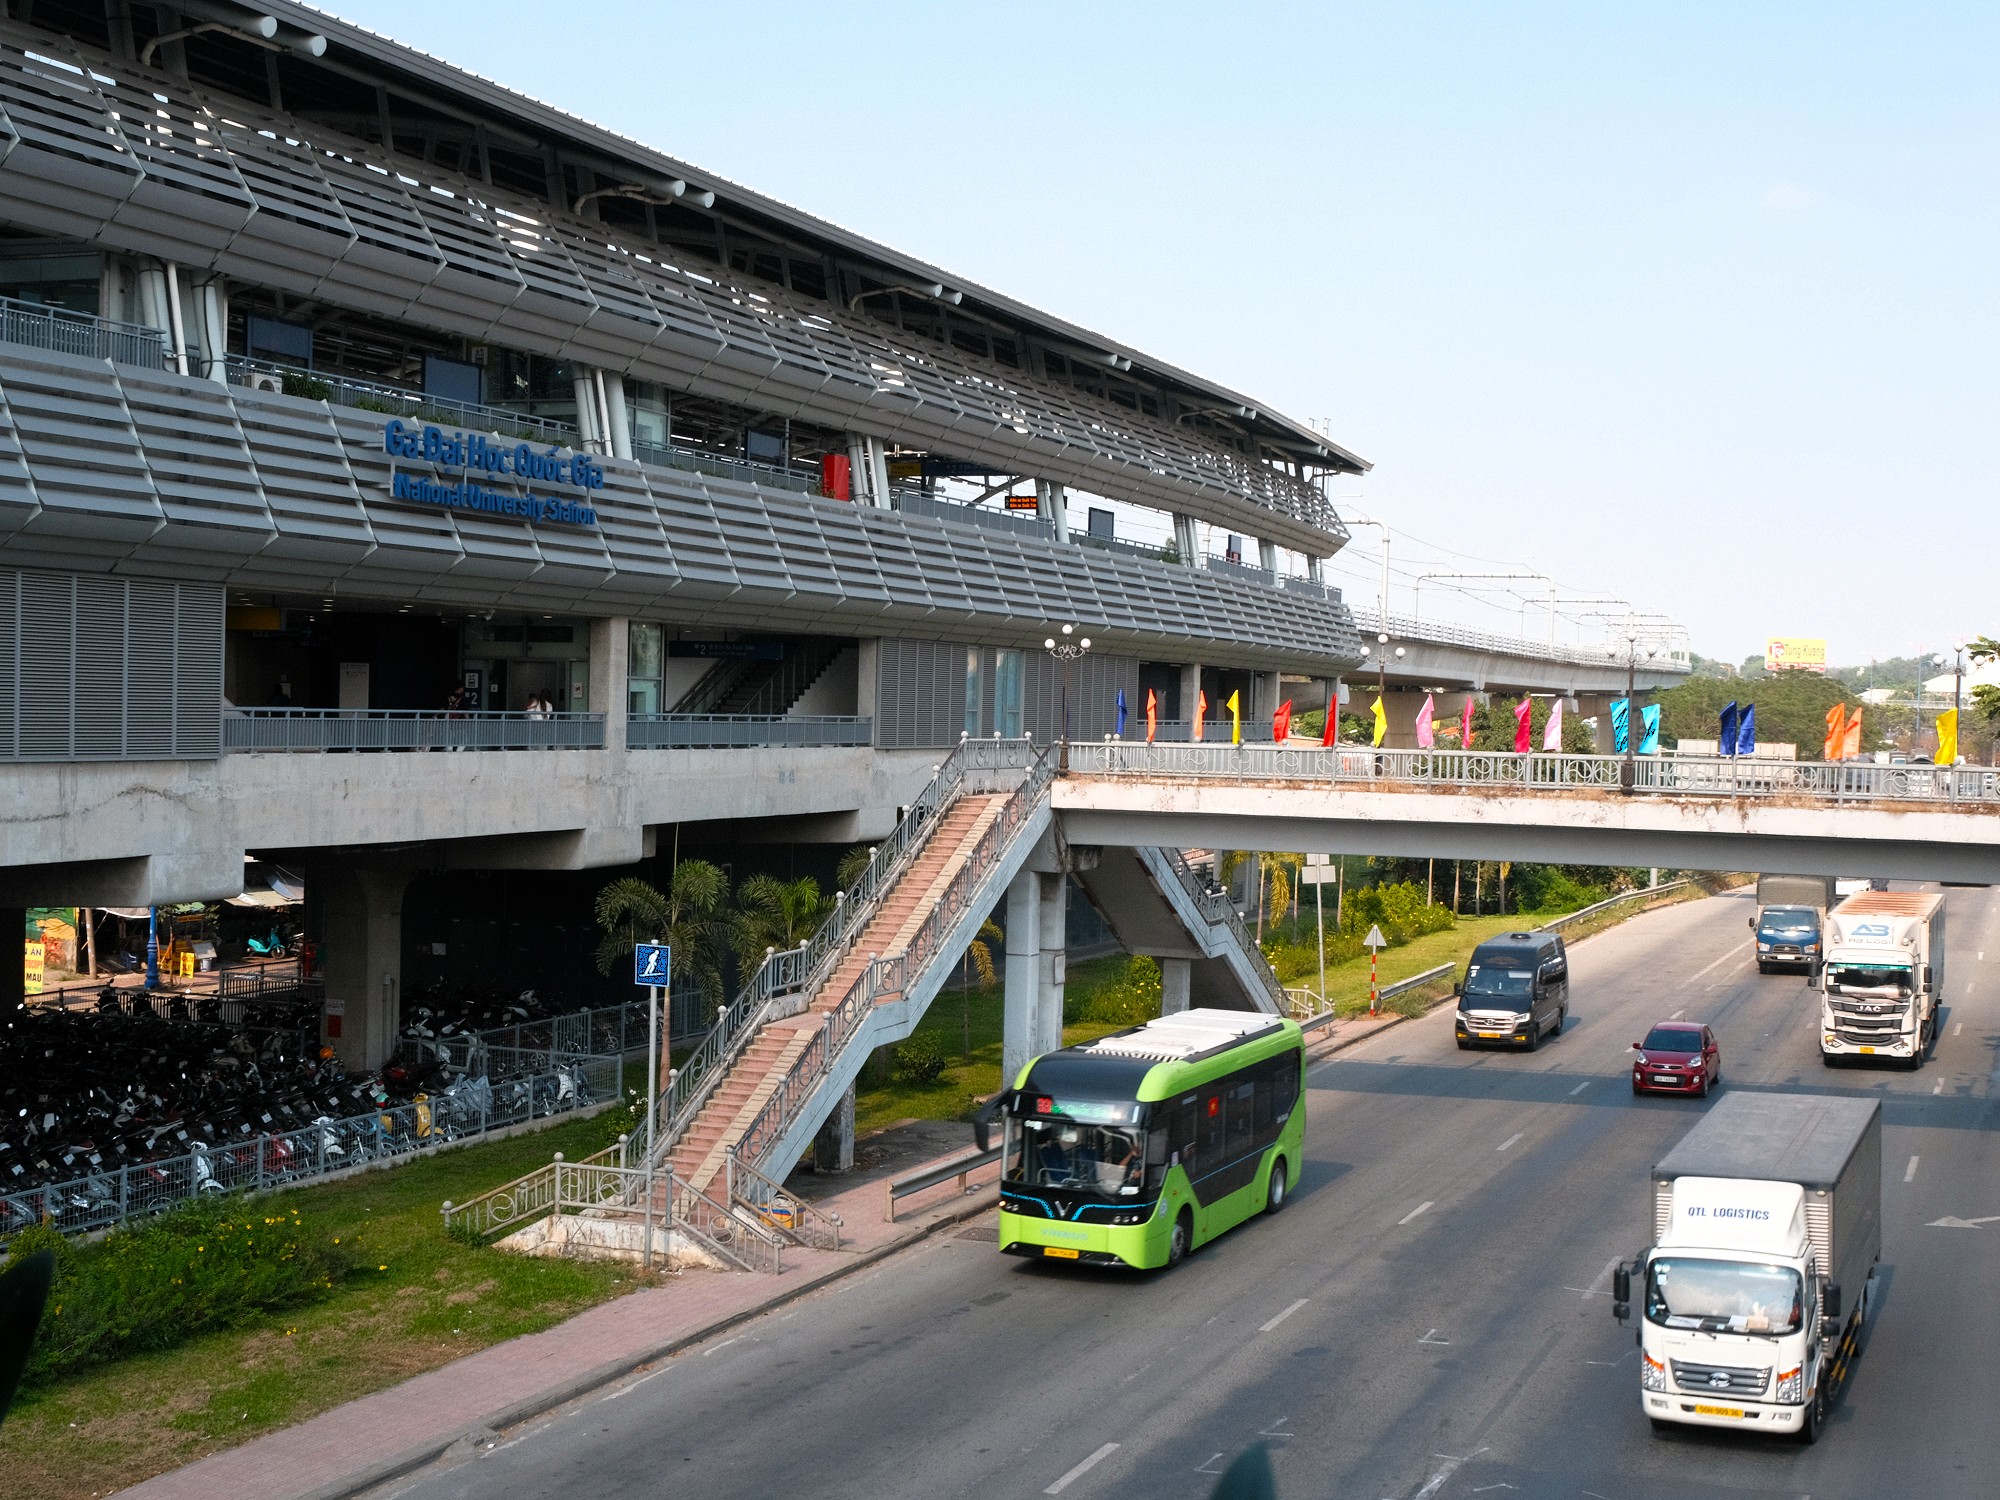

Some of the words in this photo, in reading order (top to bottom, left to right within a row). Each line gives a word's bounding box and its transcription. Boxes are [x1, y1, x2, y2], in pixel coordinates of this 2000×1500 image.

[385, 420, 418, 459] Ga
[423, 425, 463, 474] Đại
[468, 434, 511, 480] Học
[514, 443, 568, 483] Quốc
[571, 453, 604, 489] Gia
[393, 472, 465, 507] National
[467, 484, 544, 524] University
[546, 496, 595, 525] Station
[471, 692, 477, 705] 2
[1856, 1005, 1882, 1013] JAC
[1713, 1208, 1770, 1221] LOGISTICS
